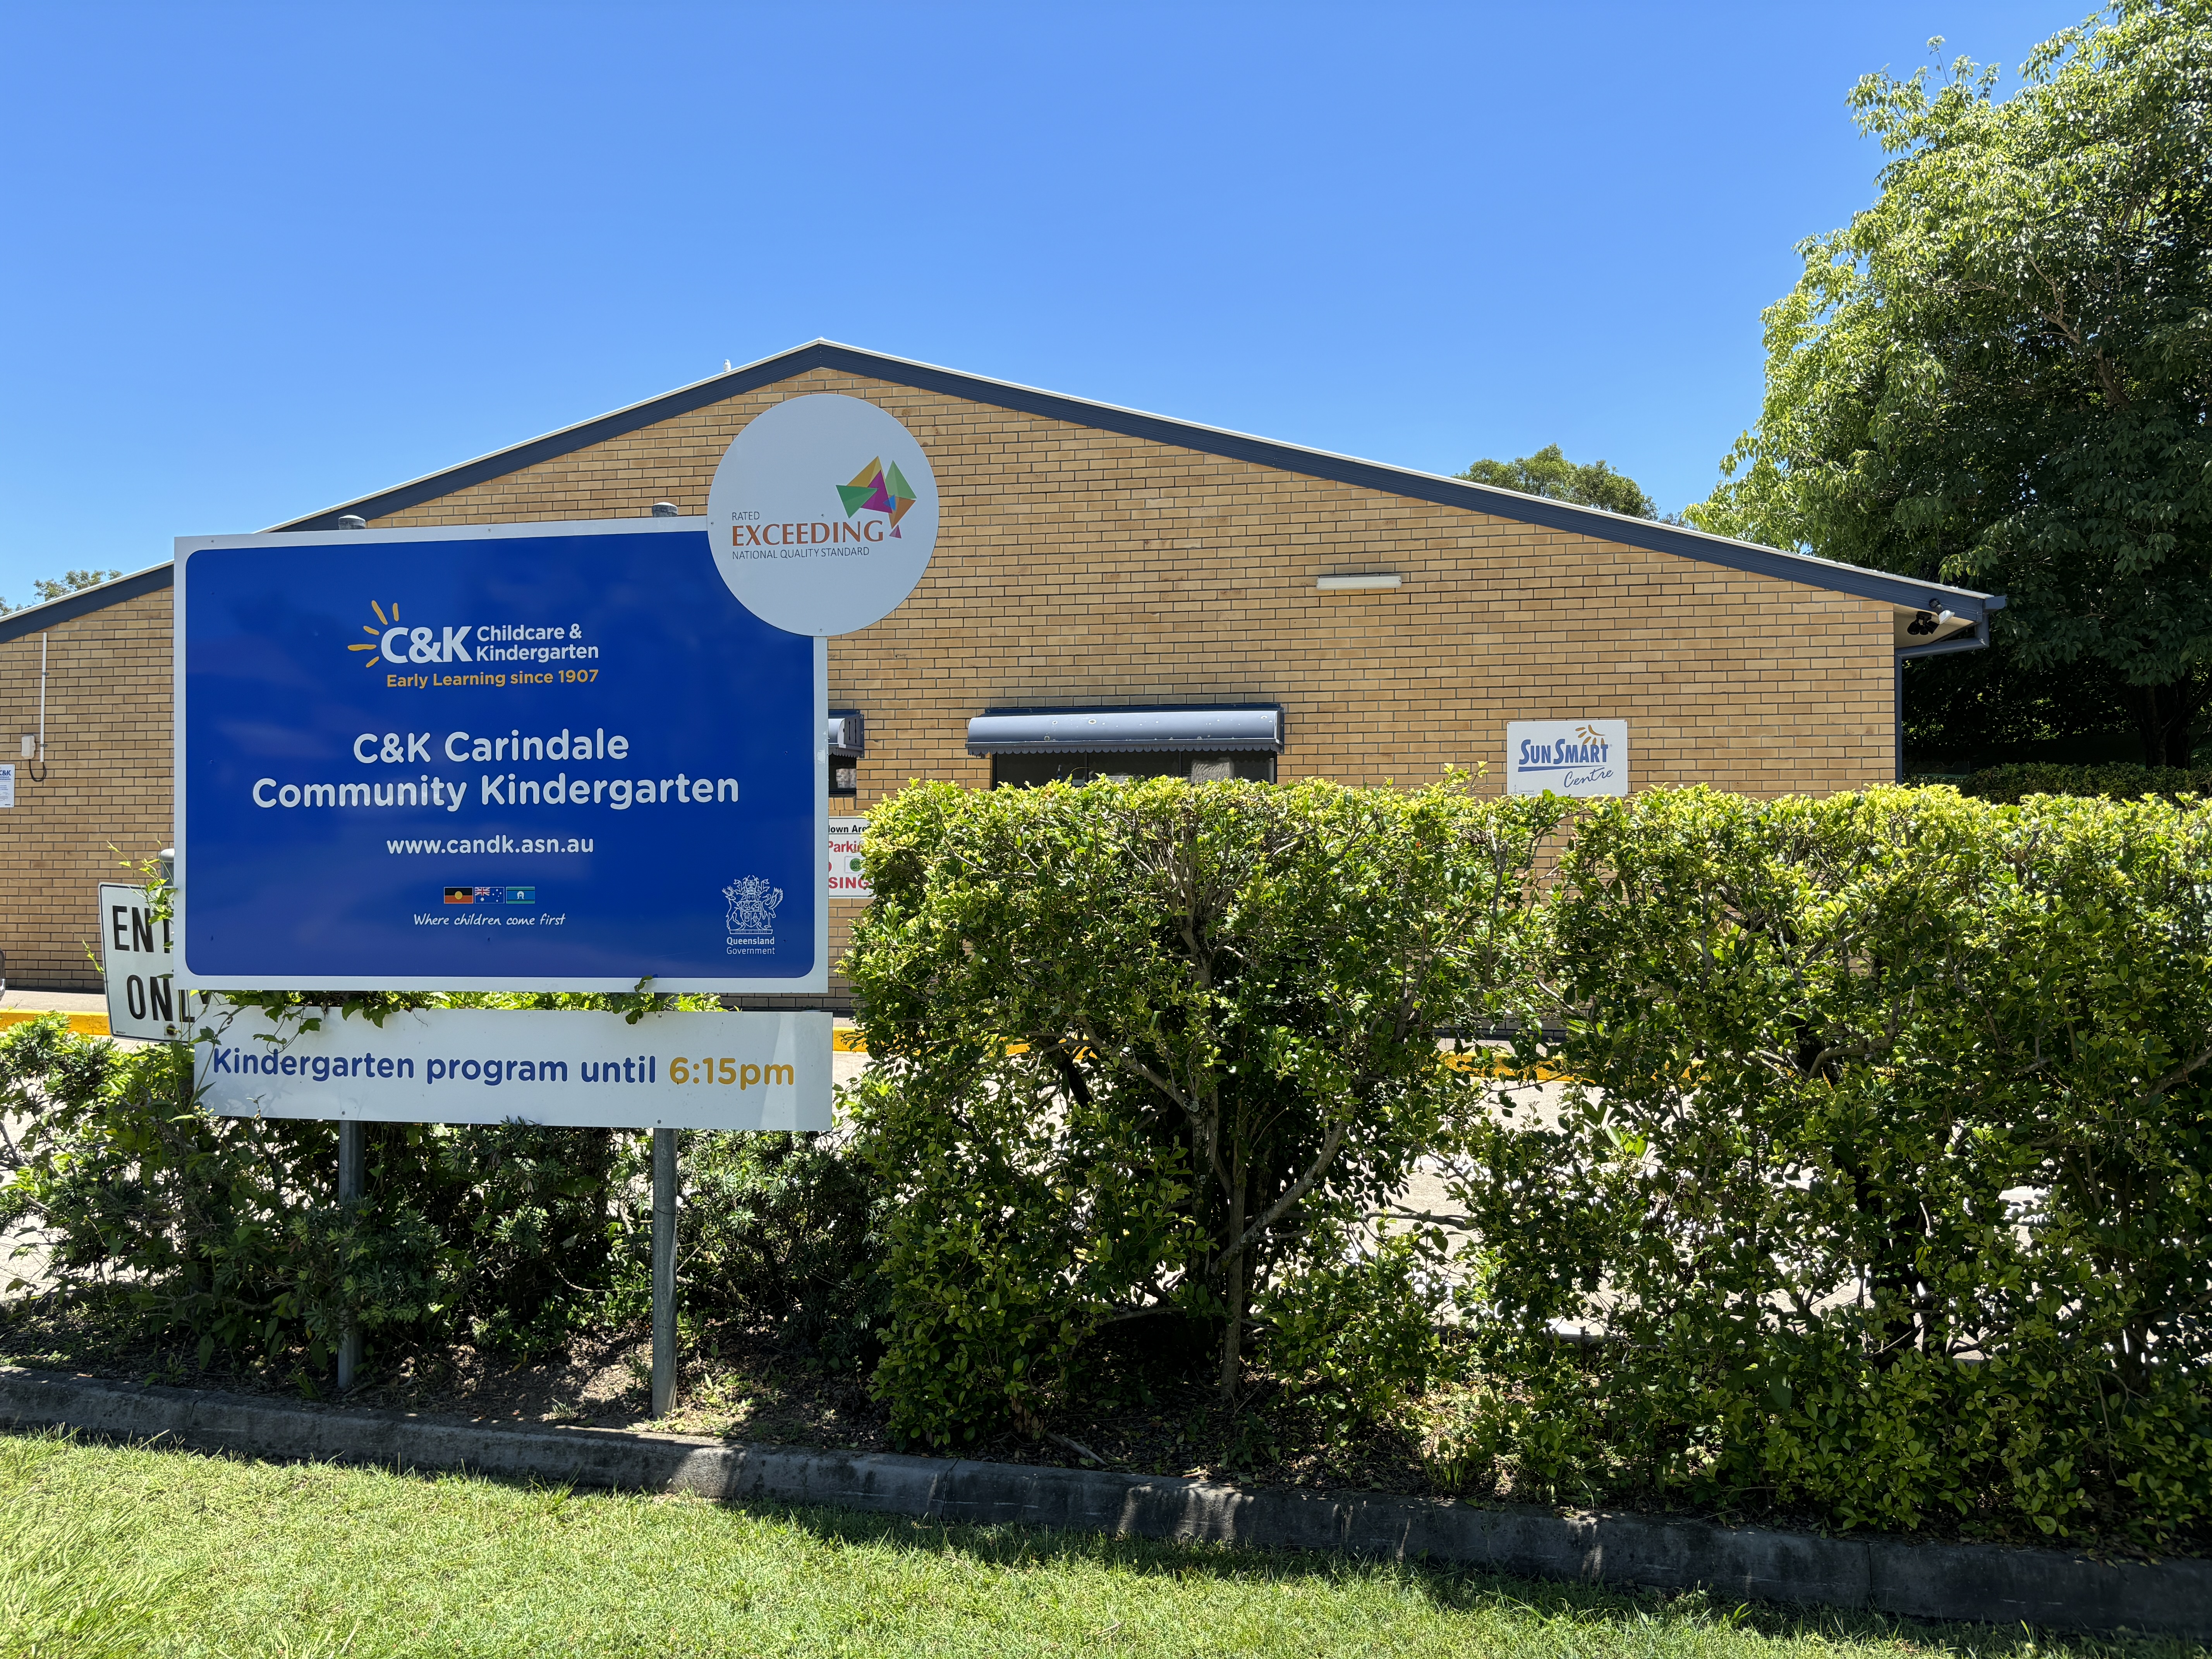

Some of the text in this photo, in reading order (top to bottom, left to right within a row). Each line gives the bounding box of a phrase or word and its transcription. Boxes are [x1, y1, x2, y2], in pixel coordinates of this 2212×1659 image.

[732, 511, 760, 521] RATED
[732, 520, 883, 546] EXCEEDING
[732, 547, 869, 560] NATIONAL QUALITY STANDARD
[477, 623, 582, 642] Childcare &
[381, 626, 473, 663] C&K
[477, 644, 599, 663] Kindergarten
[387, 670, 598, 689] Early Learning since 1907
[354, 728, 629, 763] C&K Carindale
[1564, 767, 1614, 788] Centre
[252, 773, 738, 812] Community Kindergarten
[386, 835, 593, 854] www.candk.asn.au
[414, 913, 449, 925] Where
[454, 913, 501, 926] children
[540, 913, 566, 925] first
[726, 936, 775, 946] Queensland
[215, 1049, 794, 1091] Kindergarten program until 6:15pm
